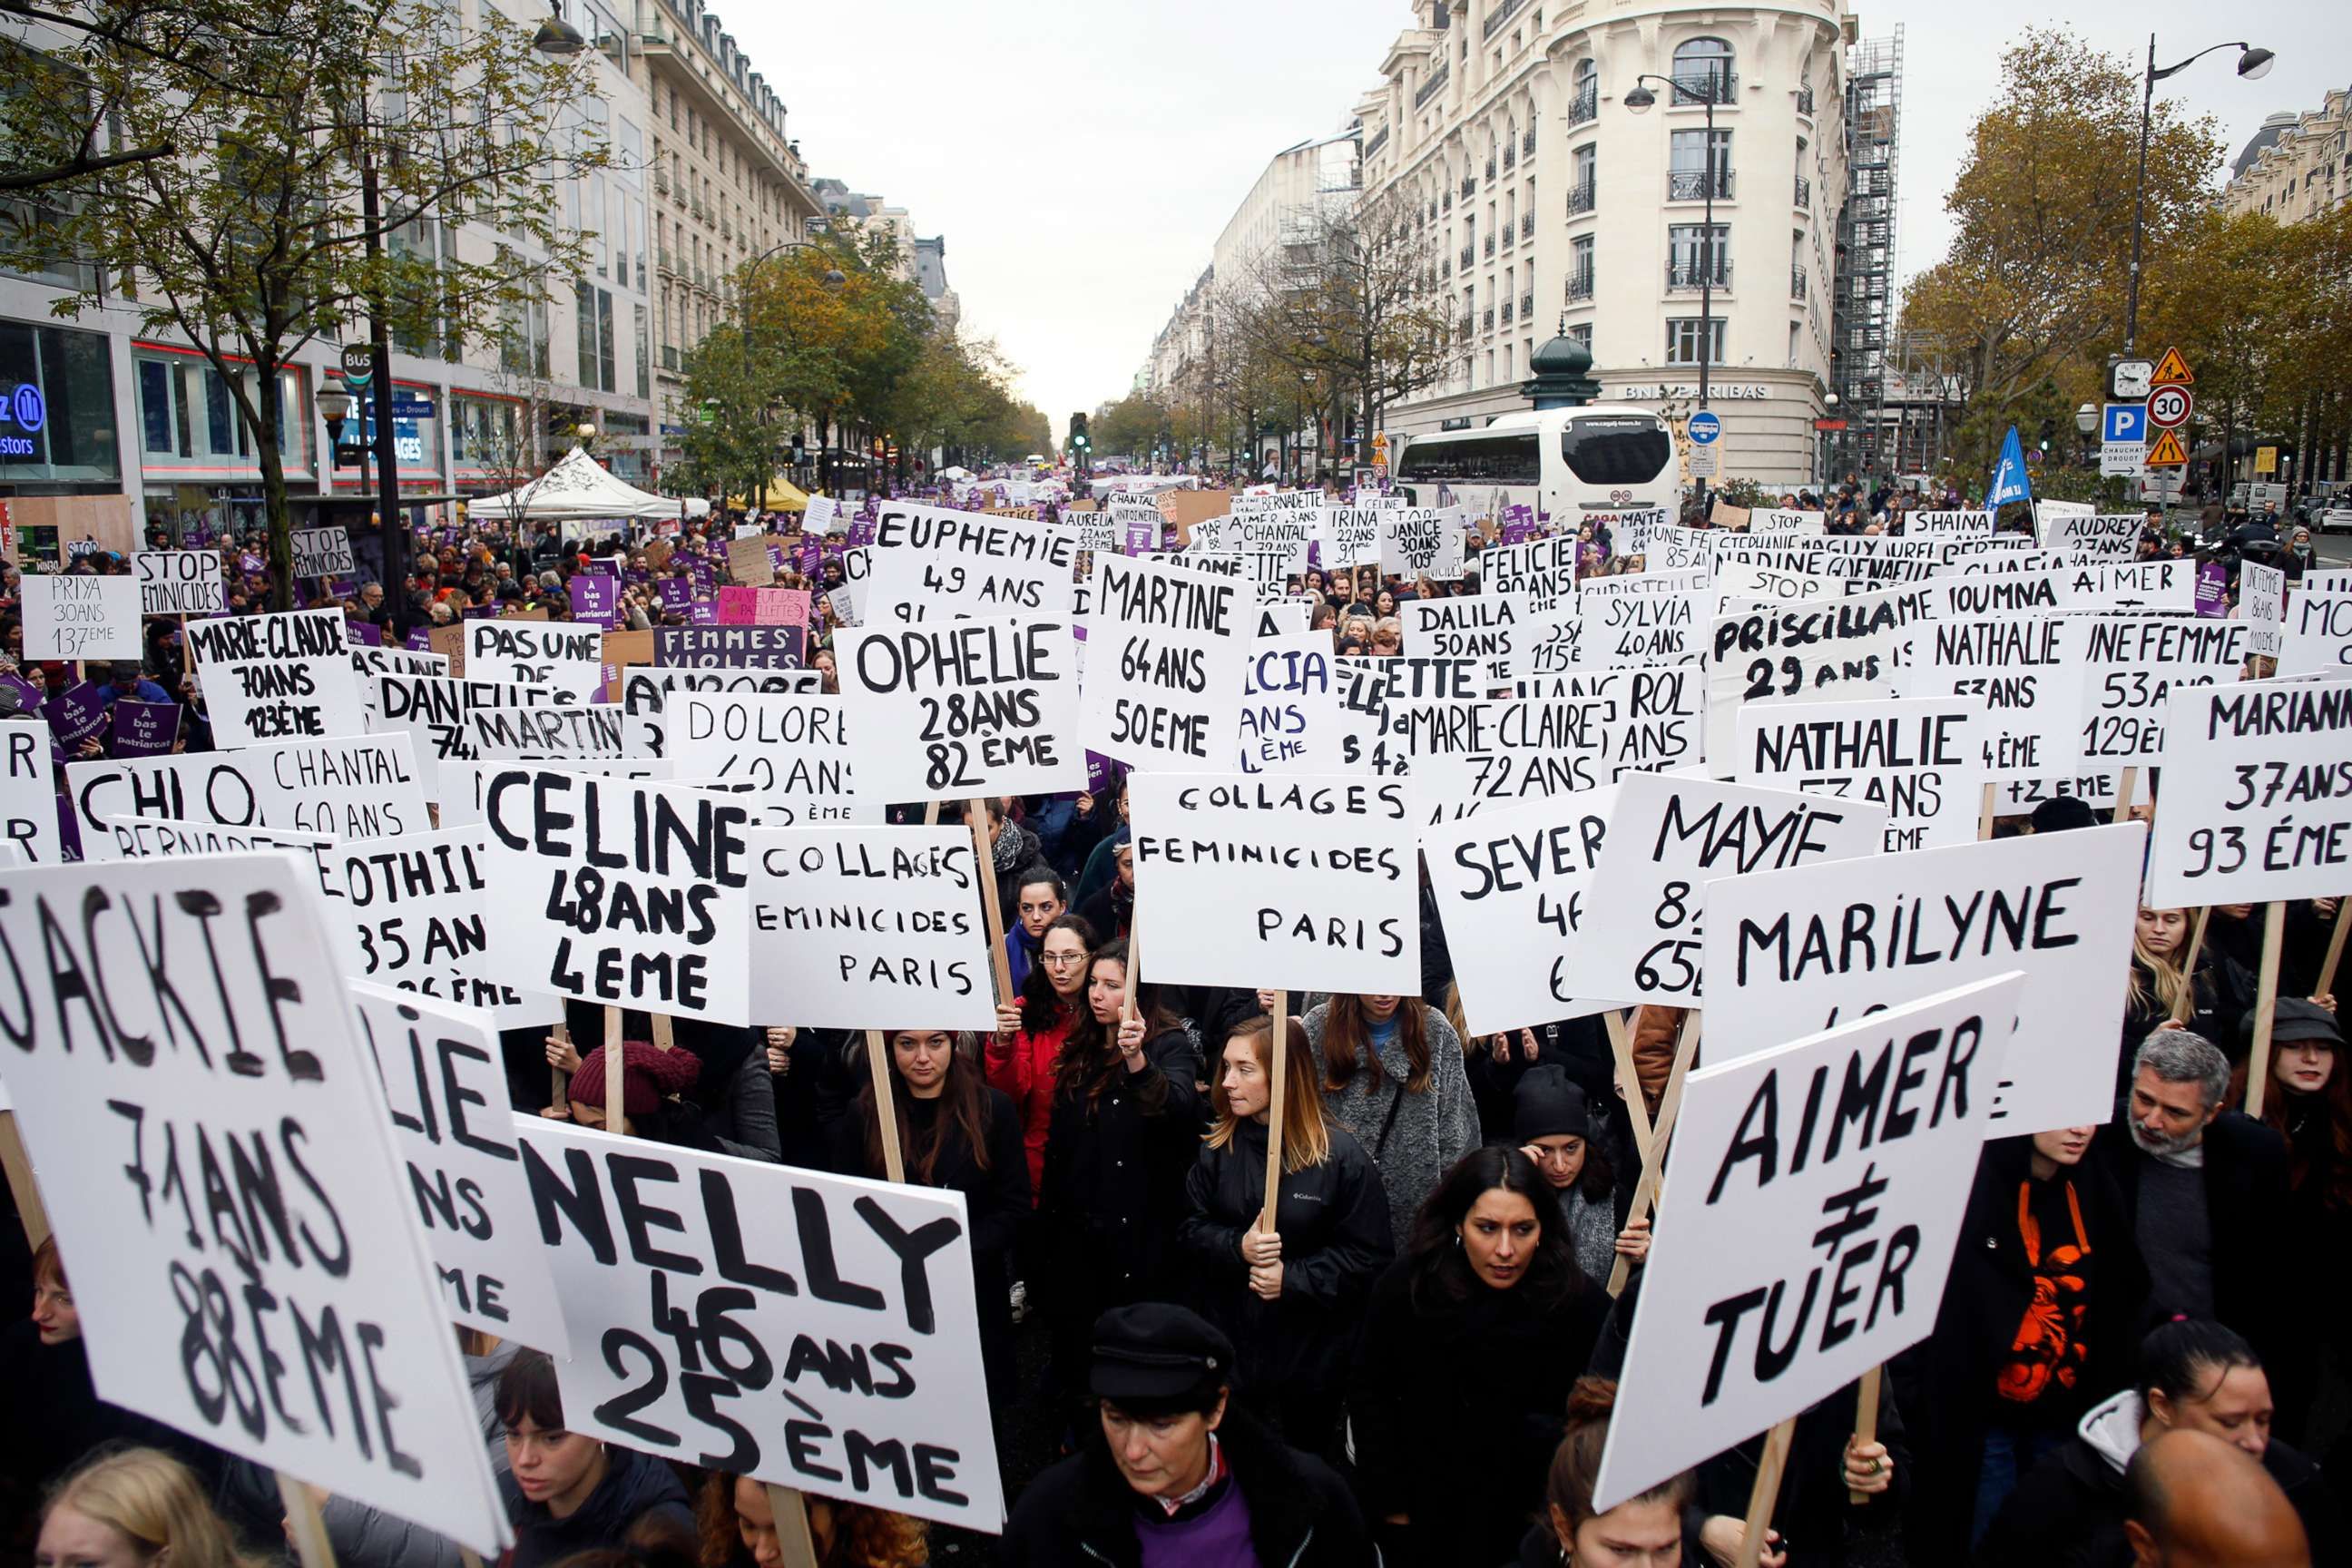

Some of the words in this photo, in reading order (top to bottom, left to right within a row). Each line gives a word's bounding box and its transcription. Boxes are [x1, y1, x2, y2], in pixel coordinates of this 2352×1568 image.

[346, 354, 370, 367] BUS
[1678, 386, 1767, 399] PARIBAS
[2156, 397, 2183, 416] 30
[2114, 411, 2135, 436] P
[1110, 493, 1156, 507] CHANTAL
[1261, 491, 1323, 512] BERNADETTE
[1365, 499, 1399, 509] CELINE
[1115, 509, 1160, 524] ANTOINETTE
[1331, 510, 1377, 528] IRINA
[1387, 519, 1442, 539] JANICE
[1766, 514, 1802, 530] STOP
[1915, 512, 1990, 532] SHAINA
[2064, 517, 2142, 536] AUDREY
[289, 531, 348, 554] STOP
[877, 513, 1075, 567] EUPHEMIE
[1243, 524, 1308, 541] CHANTAL
[1653, 526, 1685, 546] UNE
[138, 553, 218, 582] STOP
[1482, 538, 1573, 583] FELICIE
[52, 576, 102, 601] PRIYA
[924, 564, 965, 593] 49
[978, 575, 1044, 608] ANS
[1749, 572, 1818, 599] STOP
[2073, 563, 2173, 593] AIMER
[142, 582, 222, 612] EMINICIDES
[583, 591, 601, 599] bas
[589, 600, 598, 608] le
[1100, 564, 1234, 637] MARTINE
[575, 610, 612, 619] patriarcat
[1417, 600, 1515, 632] DALILA
[1605, 595, 1691, 629] SYLVIA
[190, 614, 348, 663] MARIE-CLAUDE
[475, 625, 537, 659] PAS
[543, 632, 601, 662] UNE
[664, 630, 789, 652] FEMMES
[1714, 601, 1896, 662] PRISCILLA
[1936, 621, 2064, 666] NATHALIE
[2140, 622, 2248, 665] FEMME
[352, 651, 389, 677] AS
[663, 653, 799, 670] VIOLEES
[857, 618, 1061, 692] OPHELIE
[1743, 656, 1803, 703] 29
[1815, 655, 1880, 688] ANS
[64, 705, 85, 720] bas
[74, 716, 87, 725] le
[133, 718, 157, 729] bas
[61, 713, 104, 743] patriarcat
[117, 737, 171, 749] patriarcat
[139, 729, 152, 739] le
[475, 708, 622, 751] MARTIN
[1411, 703, 1602, 756] MARIE-CLAIRE
[2082, 716, 2164, 757] 129È
[1755, 714, 1968, 773] NATHALIE
[274, 748, 411, 789] CHANTAL
[1179, 783, 1406, 819] COLLAGES
[348, 801, 403, 838] ANS
[486, 771, 748, 888] CELINE
[763, 842, 969, 889] COLLAGES
[1139, 837, 1401, 881] FEMINICIDES
[1455, 815, 1606, 900] SEVER
[755, 905, 970, 935] EMINICIDES
[1258, 907, 1404, 958] PARIS
[1737, 877, 2083, 987] MARILYNE
[0, 884, 325, 1083] JACKIE
[839, 955, 973, 995] PARIS
[1705, 1014, 1983, 1206] AIMER
[518, 1137, 963, 1336] NELLY
[1701, 1224, 1921, 1409] TUER
[651, 1269, 774, 1390] 46
[782, 1334, 916, 1398] ANS
